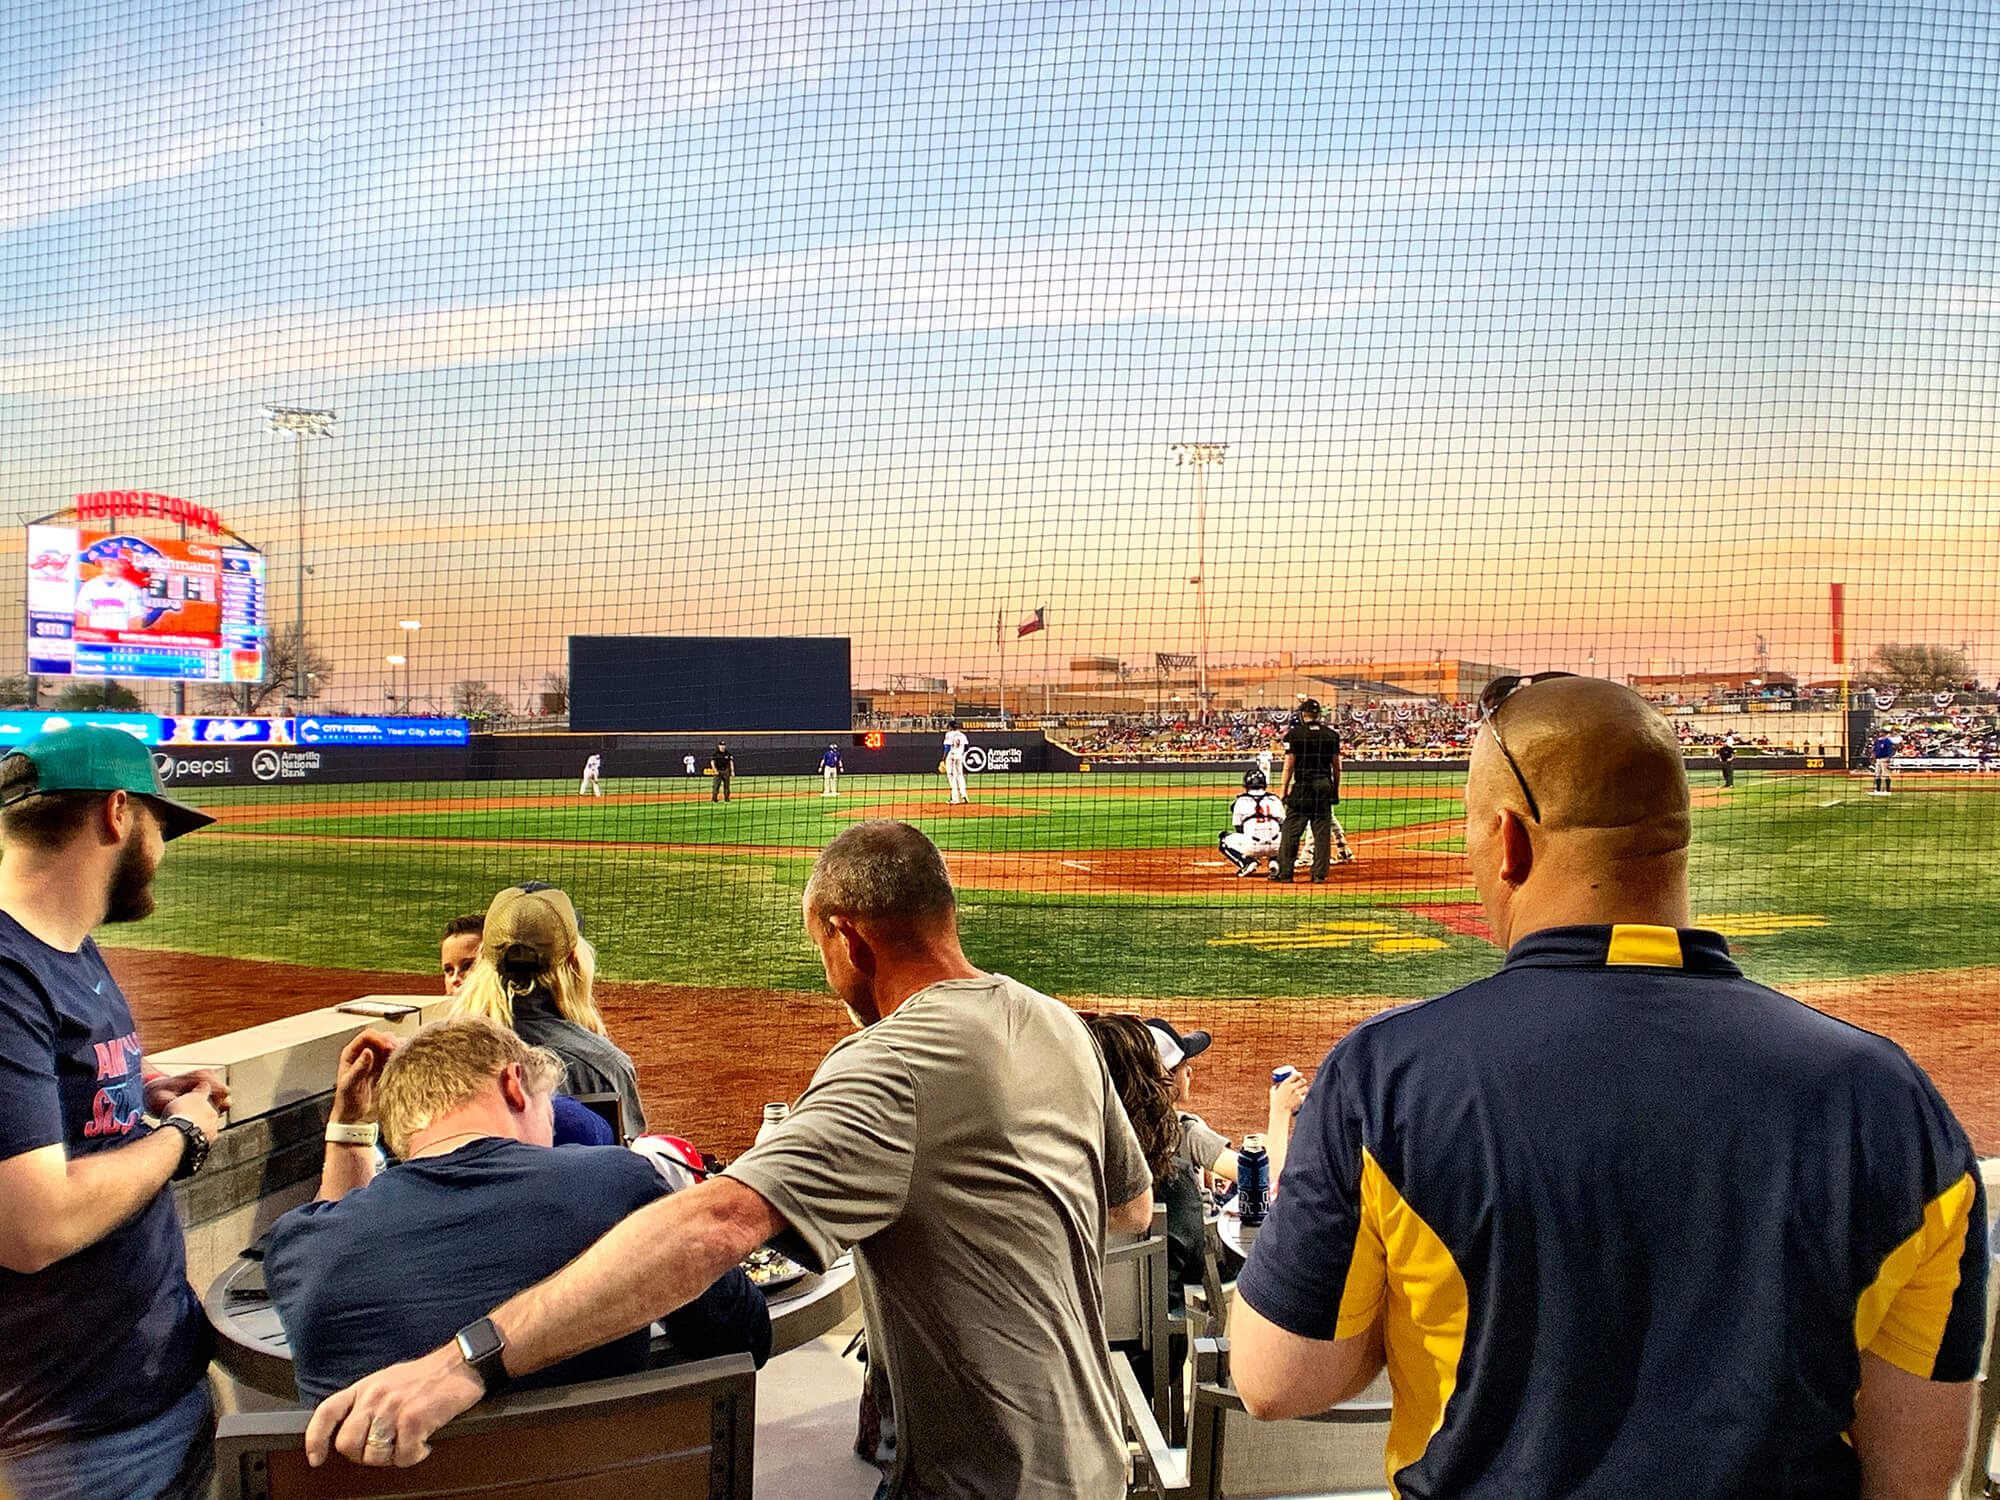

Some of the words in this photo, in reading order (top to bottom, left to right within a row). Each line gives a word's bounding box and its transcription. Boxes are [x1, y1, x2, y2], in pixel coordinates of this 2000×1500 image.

[74, 490, 221, 537] HODGETOWN
[281, 751, 321, 761] Amarillo
[987, 748, 1023, 756] Amarillo
[987, 755, 1022, 763] National
[281, 760, 320, 769] National
[987, 762, 1010, 770] Bank
[281, 768, 306, 778] Bank
